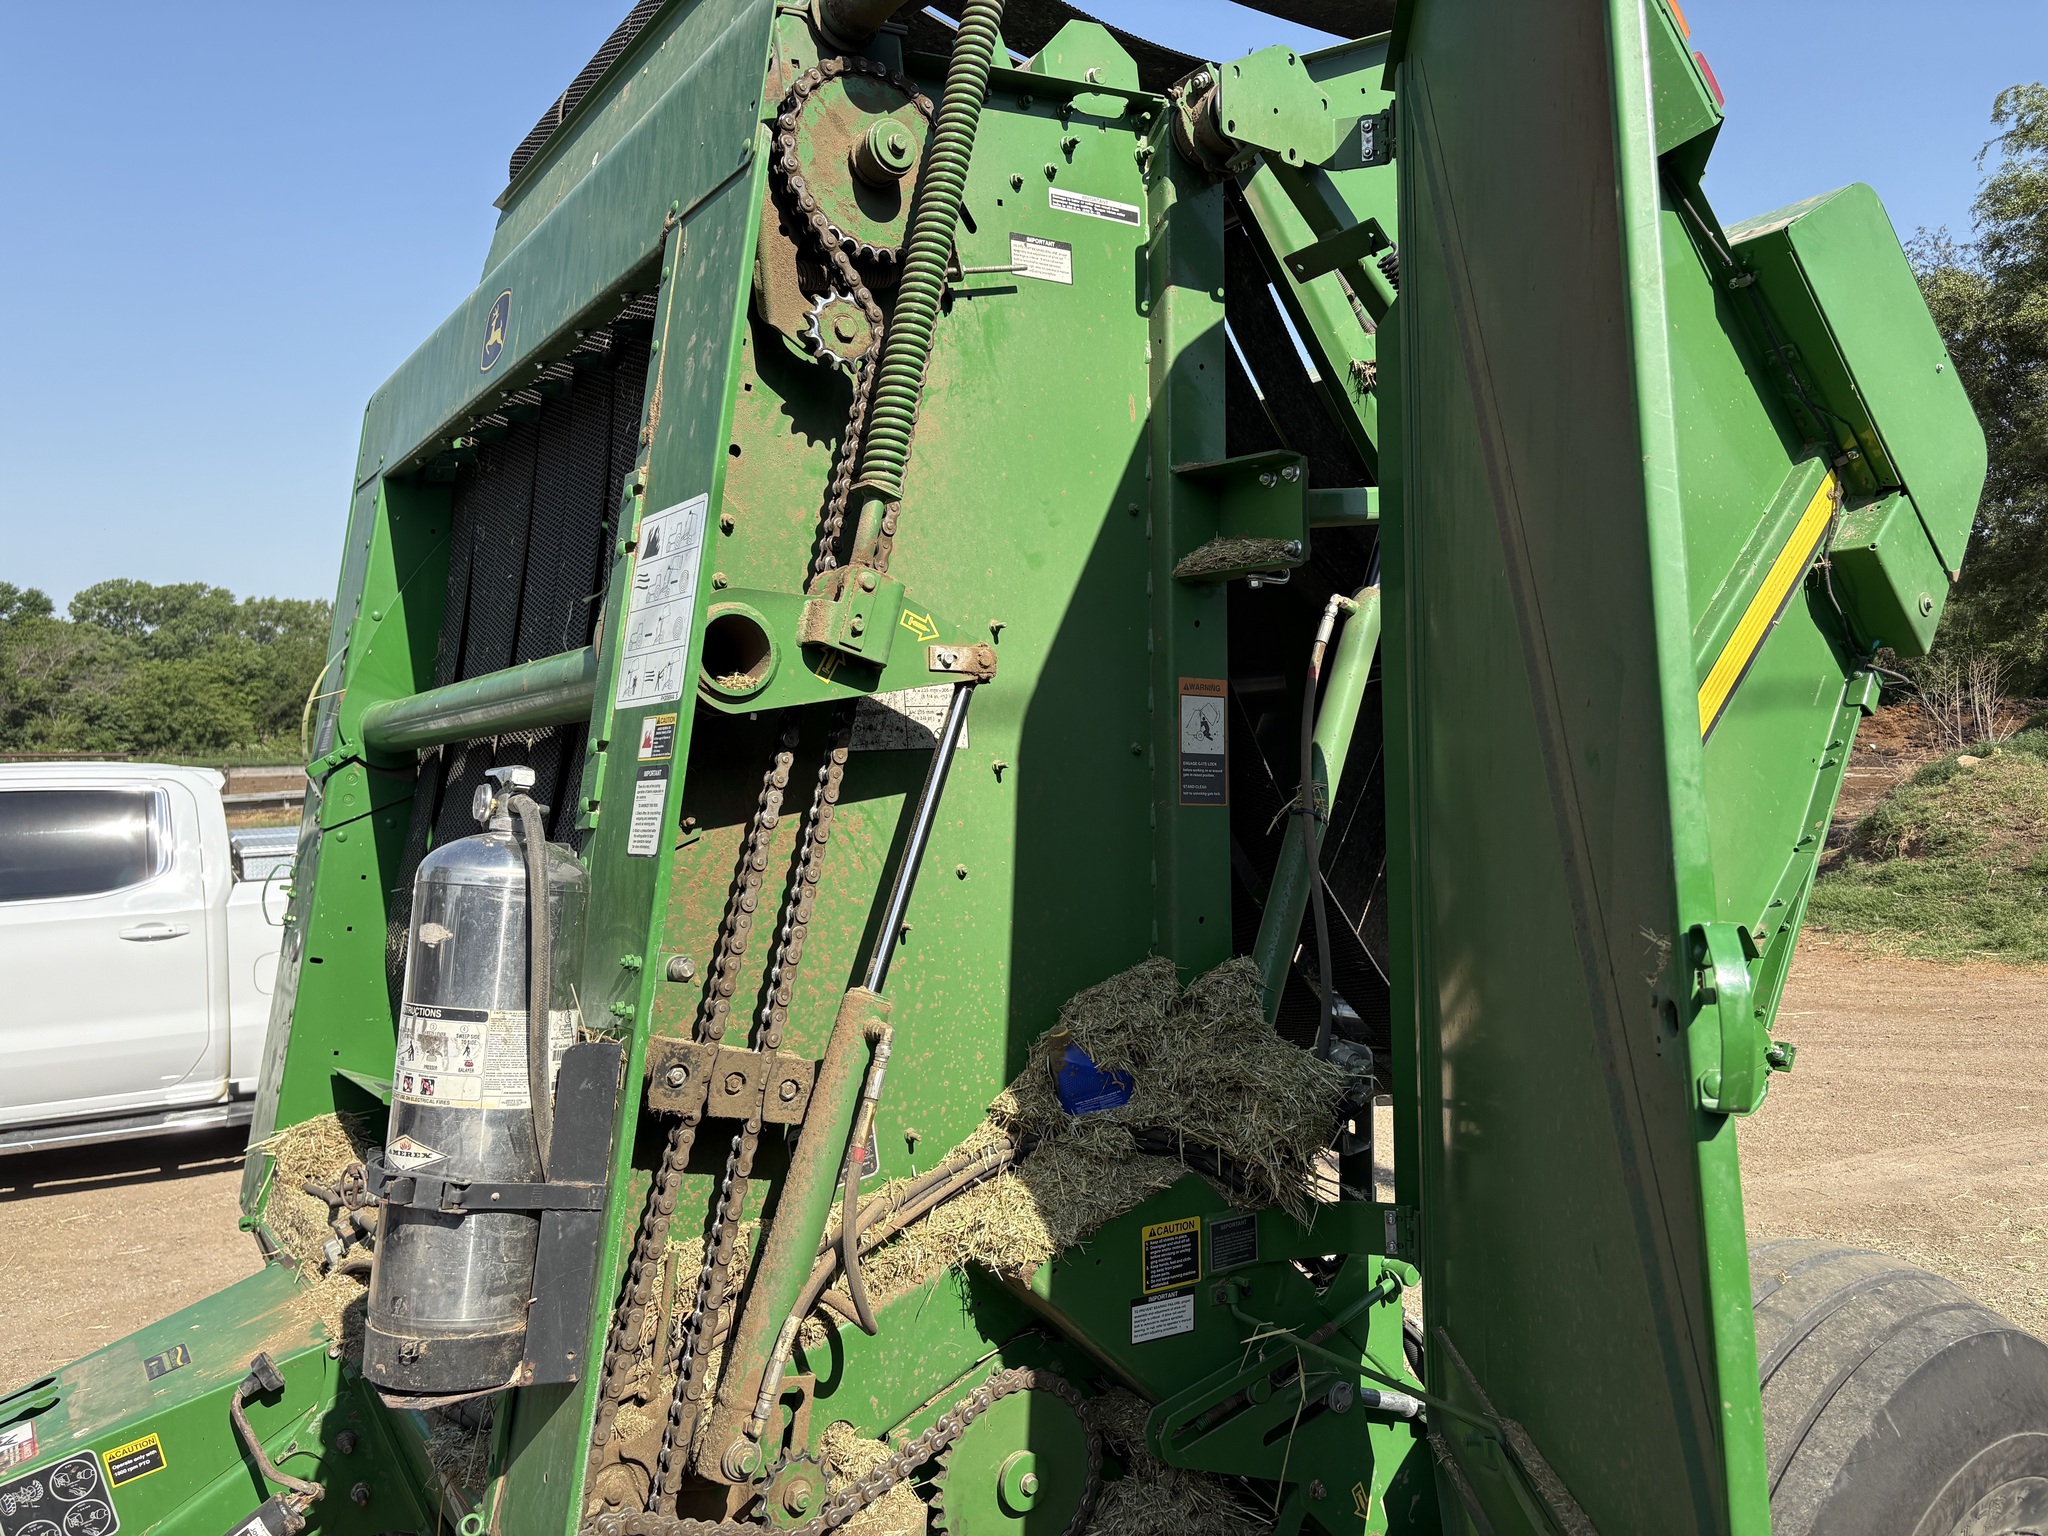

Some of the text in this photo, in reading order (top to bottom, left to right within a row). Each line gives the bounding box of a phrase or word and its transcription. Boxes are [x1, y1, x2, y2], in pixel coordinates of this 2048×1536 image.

[1026, 237, 1055, 247] IMPORTANT
[1189, 683, 1220, 692] WARNING
[644, 769, 662, 777] IMPORTANT
[411, 1096, 435, 1104] ELECTRICAL
[389, 1149, 433, 1158] AMEREX
[1157, 1220, 1194, 1236] CAUTION
[1220, 1219, 1247, 1231] IMPORTANT
[1150, 1243, 1166, 1251] Disengage
[1148, 1291, 1178, 1303] IMPORTANT
[115, 1438, 154, 1457] CAUTION
[112, 1459, 133, 1470] Operate
[145, 1449, 157, 1457] with
[138, 1459, 150, 1467] PTO
